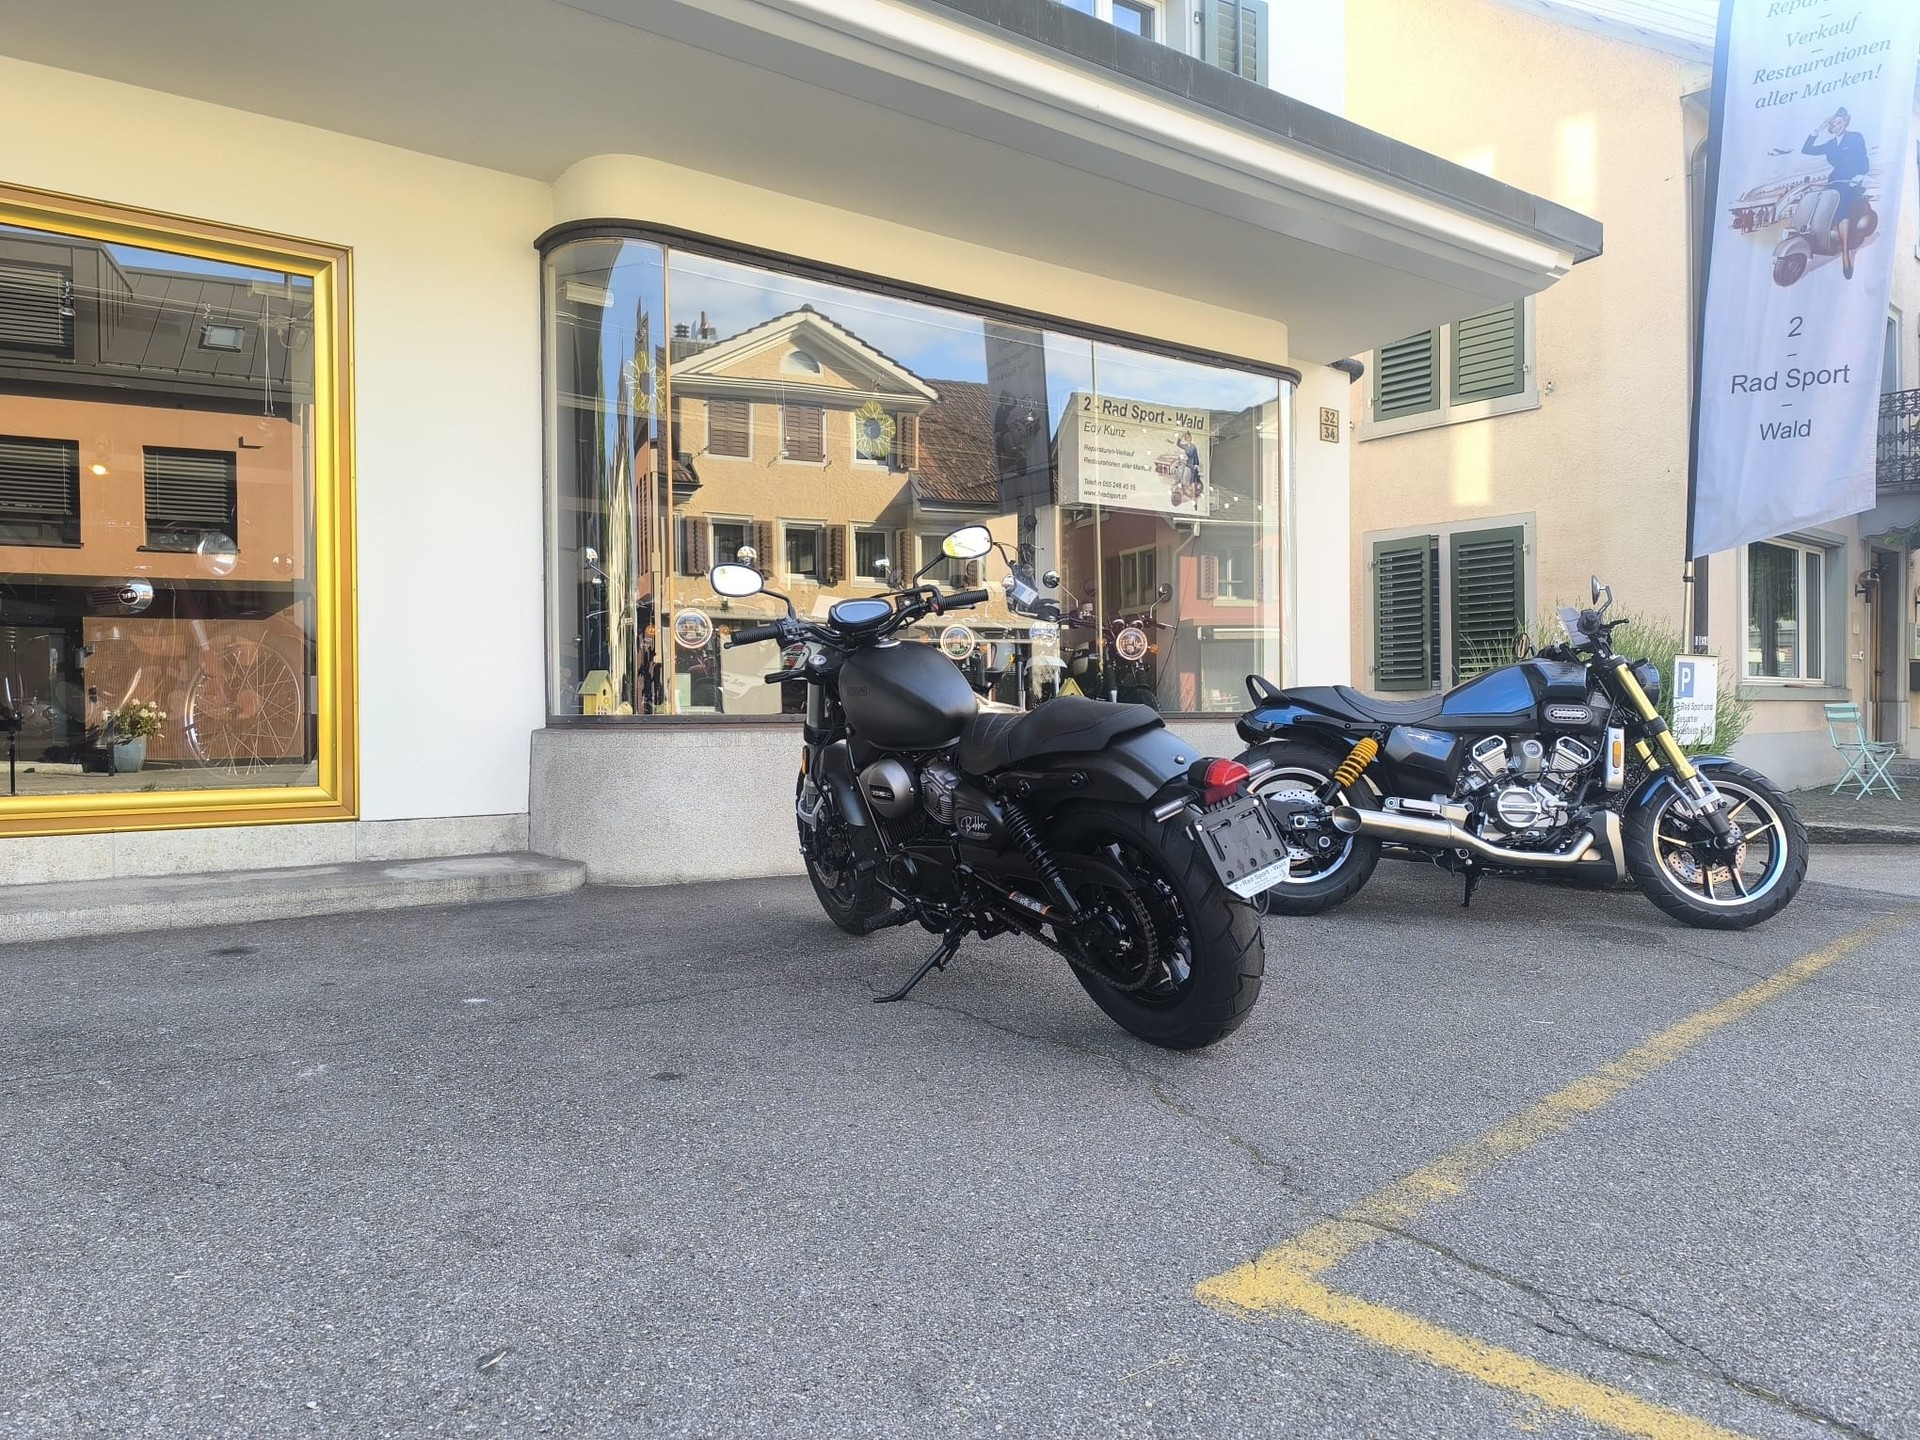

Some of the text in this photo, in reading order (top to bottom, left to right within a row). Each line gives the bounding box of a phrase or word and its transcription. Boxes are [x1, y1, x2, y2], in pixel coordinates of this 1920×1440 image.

[1786, 12, 1862, 47] Verkauf
[1752, 39, 1891, 85] Restaurationen
[1754, 63, 1883, 109] aller Marken!
[1787, 316, 1803, 338] 2
[1731, 364, 1850, 394] Rad Sport
[1083, 396, 1092, 411] 2
[1102, 400, 1128, 417] Rad
[1131, 404, 1165, 424] Sport
[1175, 412, 1205, 431] Wald
[1324, 410, 1336, 423] 32
[1104, 423, 1126, 438] Kunz
[1324, 427, 1336, 441] 34
[1760, 419, 1812, 441] Wald
